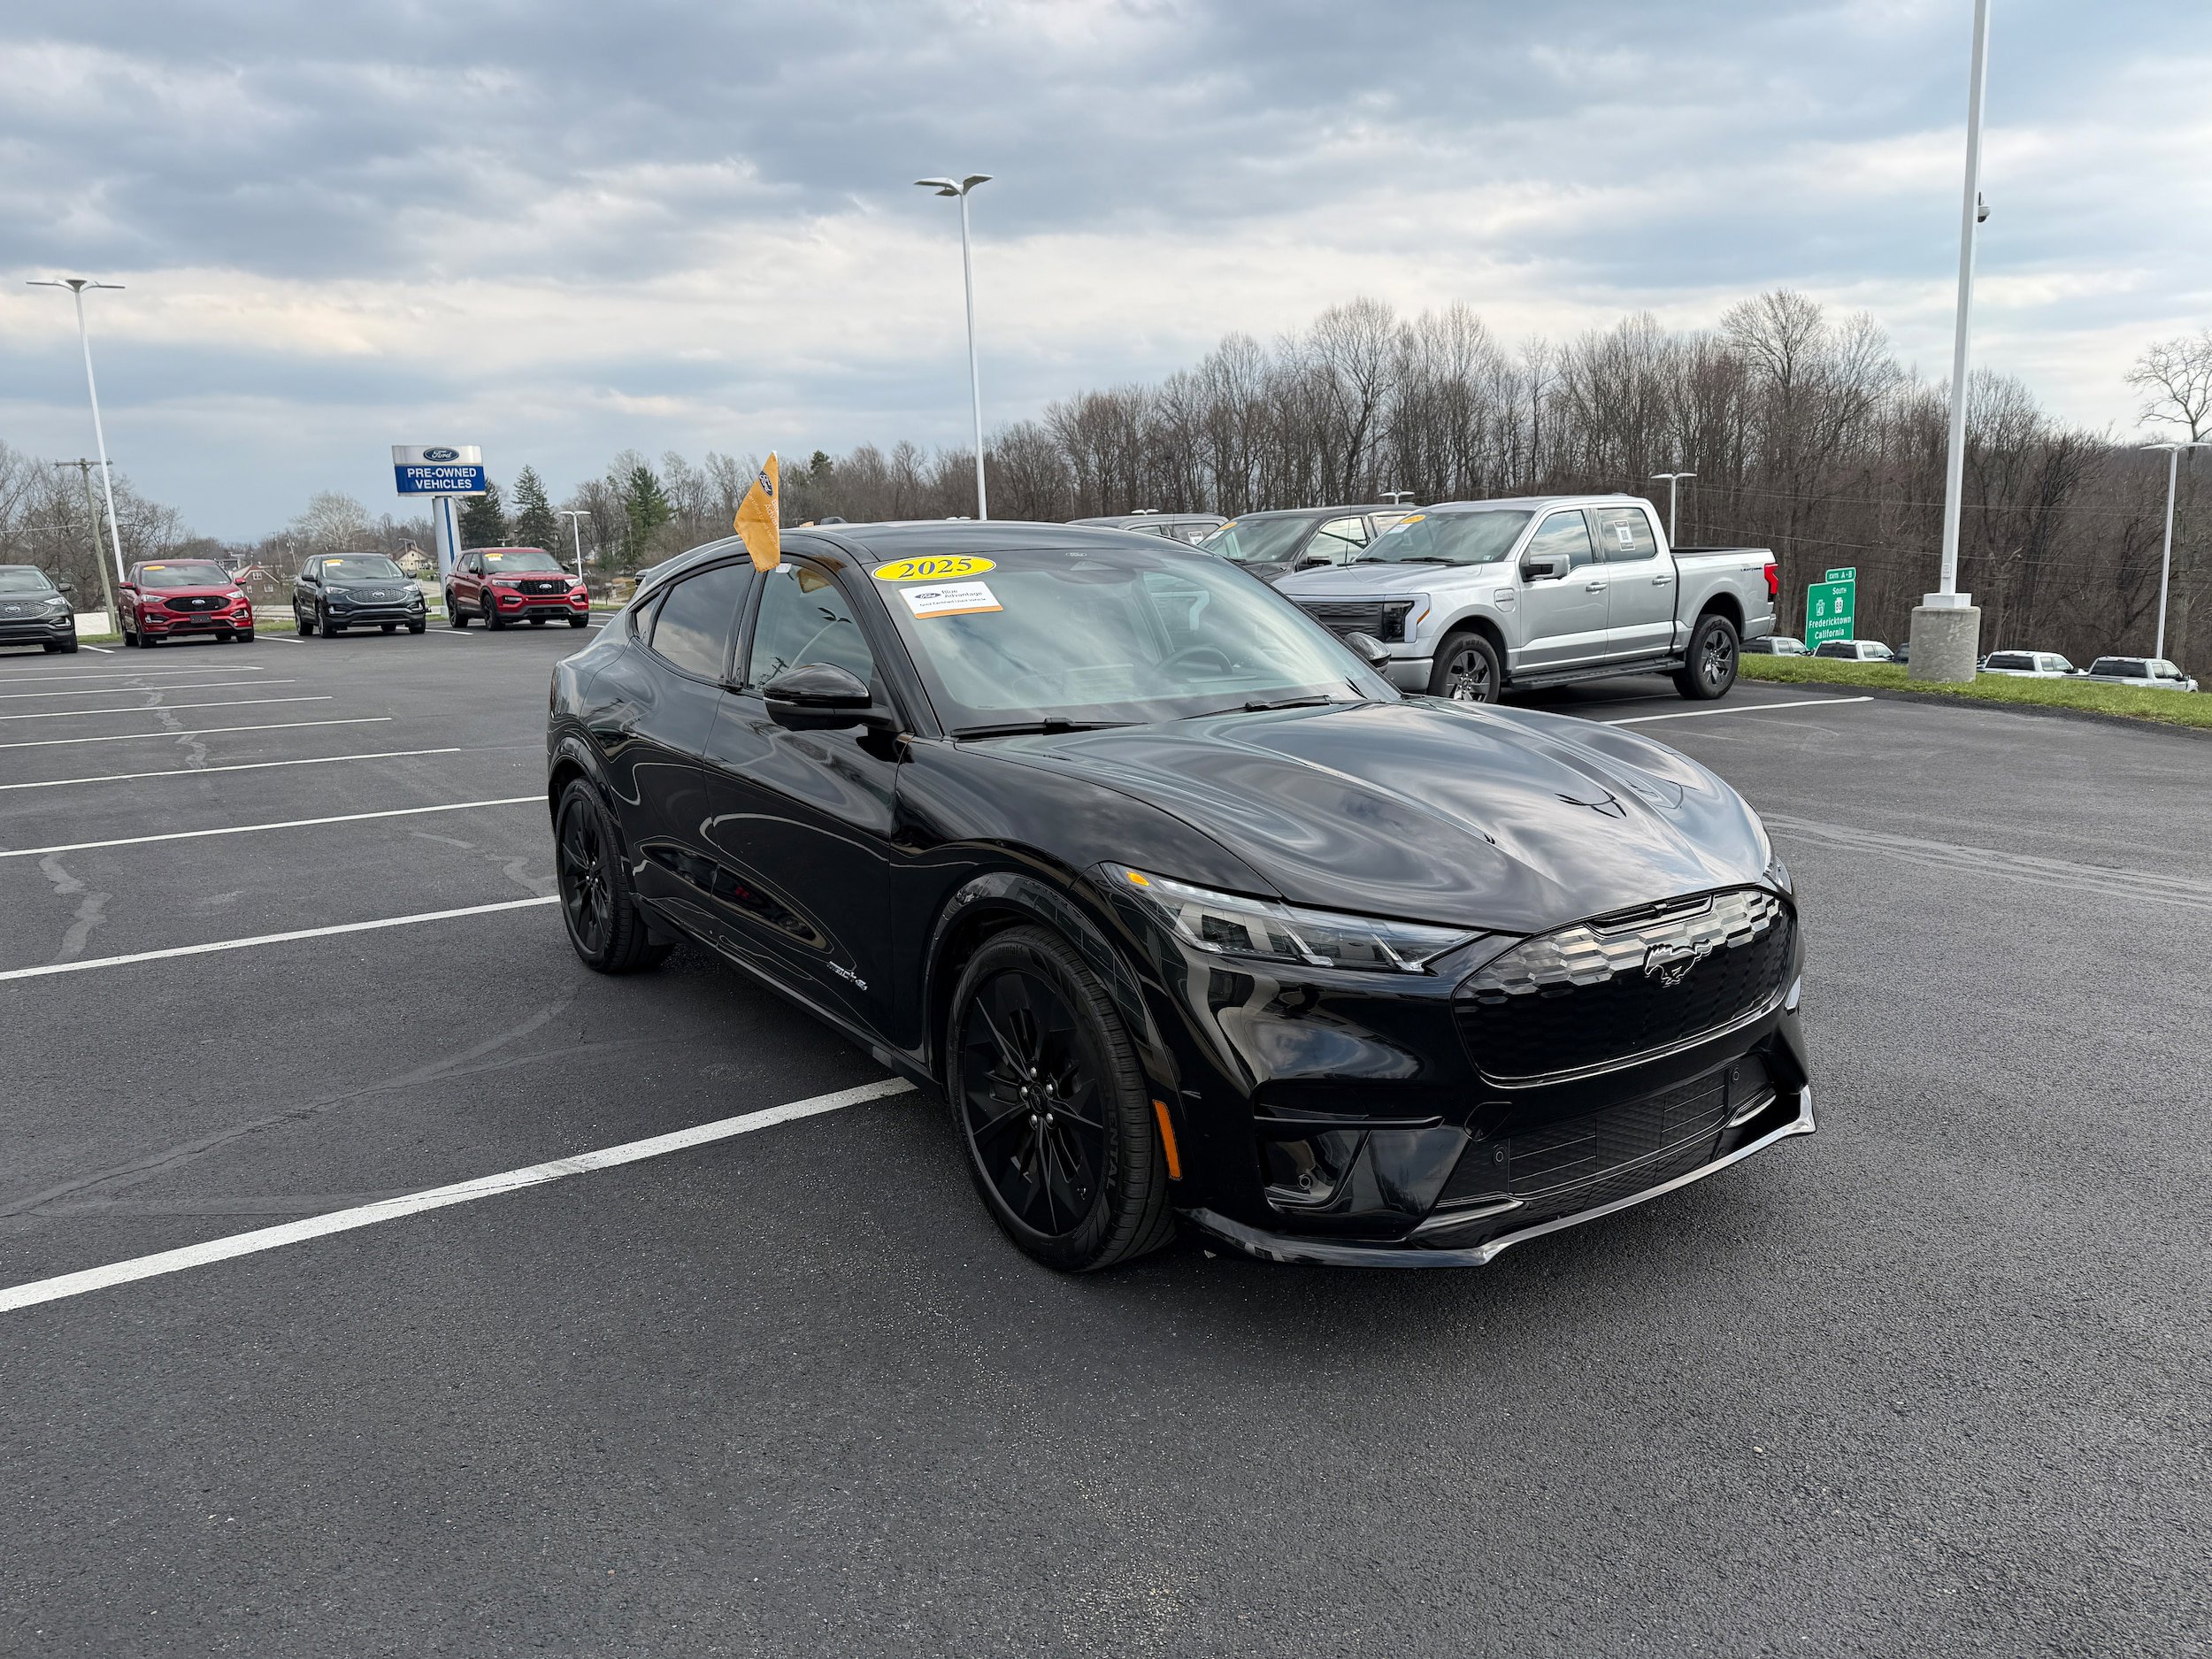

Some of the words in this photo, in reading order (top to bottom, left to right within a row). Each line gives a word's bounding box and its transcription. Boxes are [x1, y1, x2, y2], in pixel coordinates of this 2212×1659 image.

[432, 449, 452, 458] Ford
[407, 467, 476, 478] PRE-OWNED
[415, 479, 472, 488] VEHICLES
[899, 558, 972, 579] 2025
[1809, 616, 1852, 628] Fredericktown
[1815, 627, 1845, 640] California
